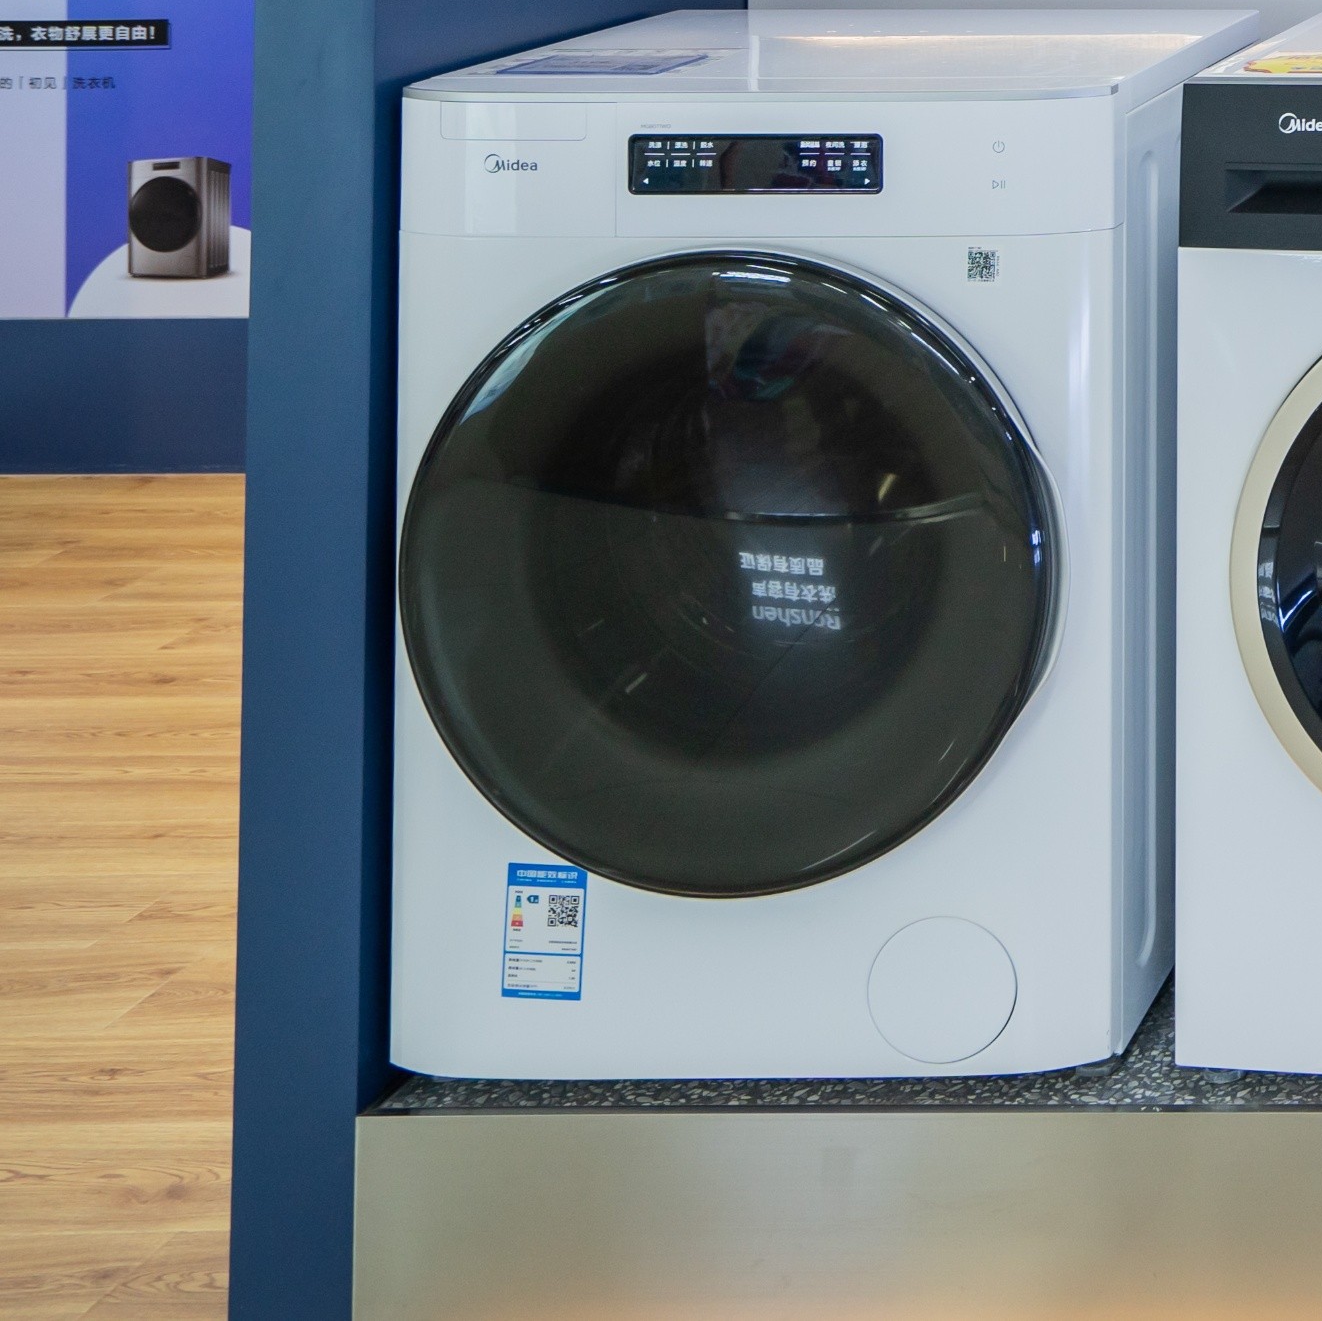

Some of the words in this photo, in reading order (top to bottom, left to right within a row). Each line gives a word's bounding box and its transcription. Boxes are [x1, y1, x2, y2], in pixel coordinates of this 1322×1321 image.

[483, 153, 538, 174] Midea
[517, 869, 578, 880] 中国能效标识
